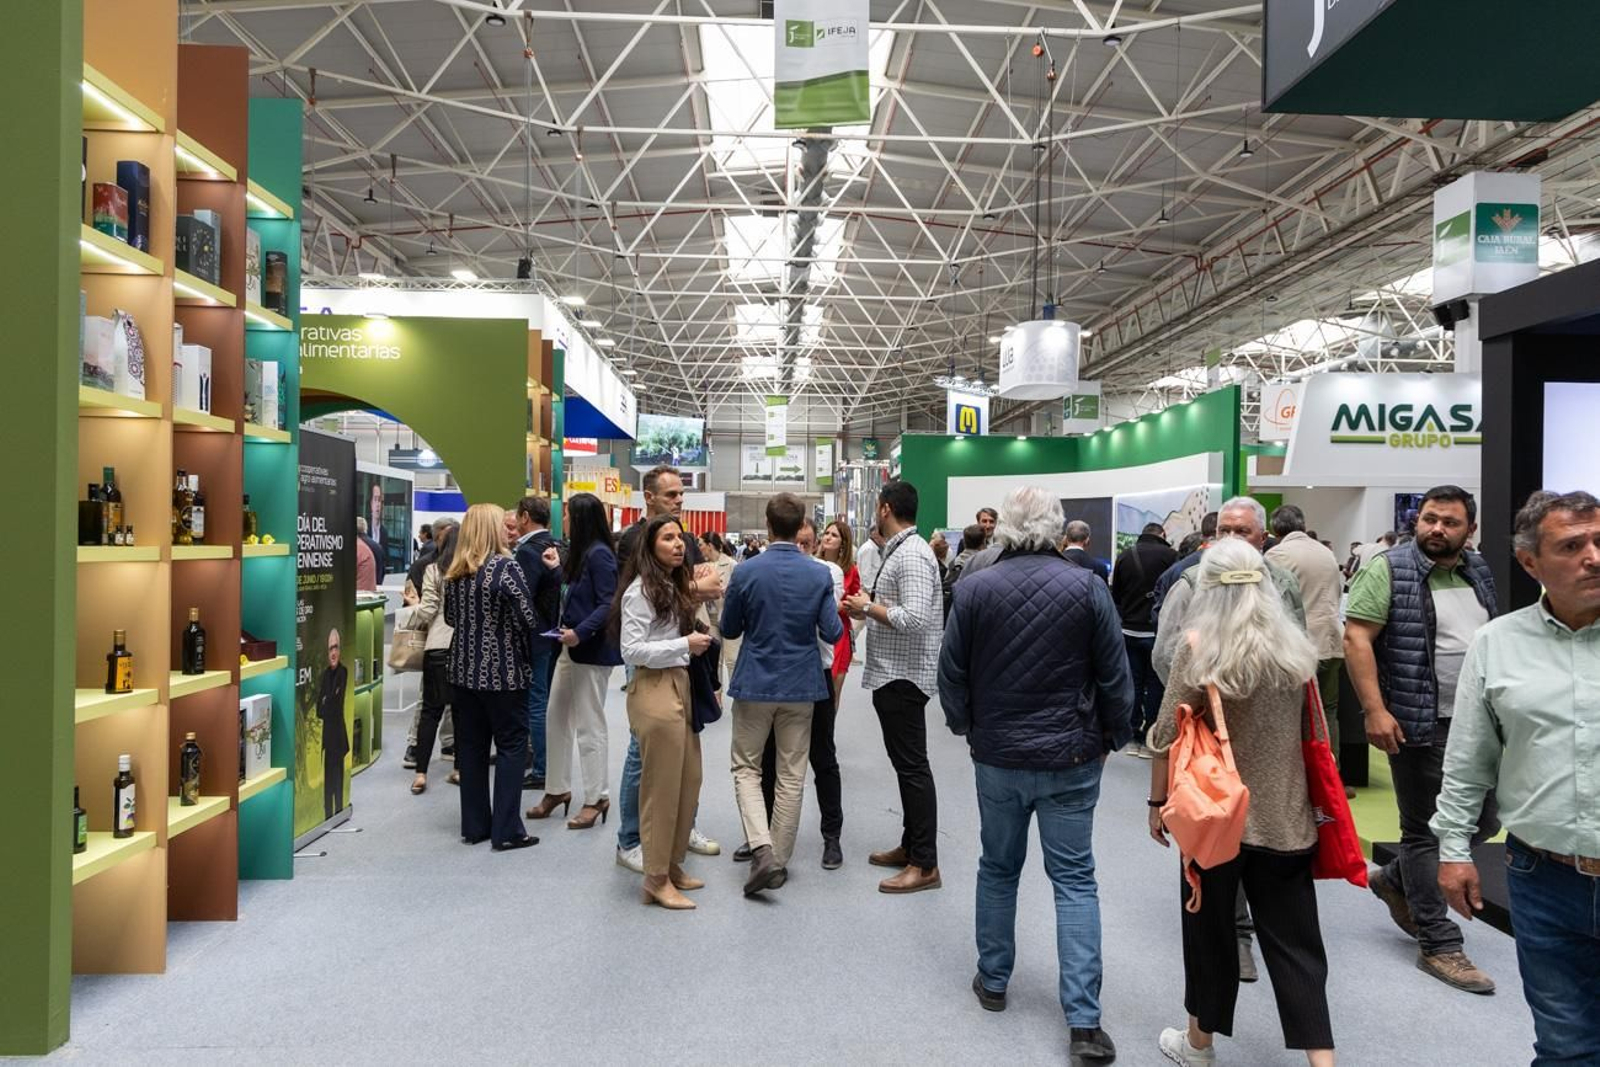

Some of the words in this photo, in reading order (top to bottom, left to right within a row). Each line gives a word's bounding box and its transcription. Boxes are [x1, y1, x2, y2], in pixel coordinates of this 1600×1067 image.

[1477, 235, 1500, 244] CAJA
[1389, 433, 1452, 449] GRUPO
[298, 512, 311, 532] DÍA
[312, 516, 327, 533] DEL
